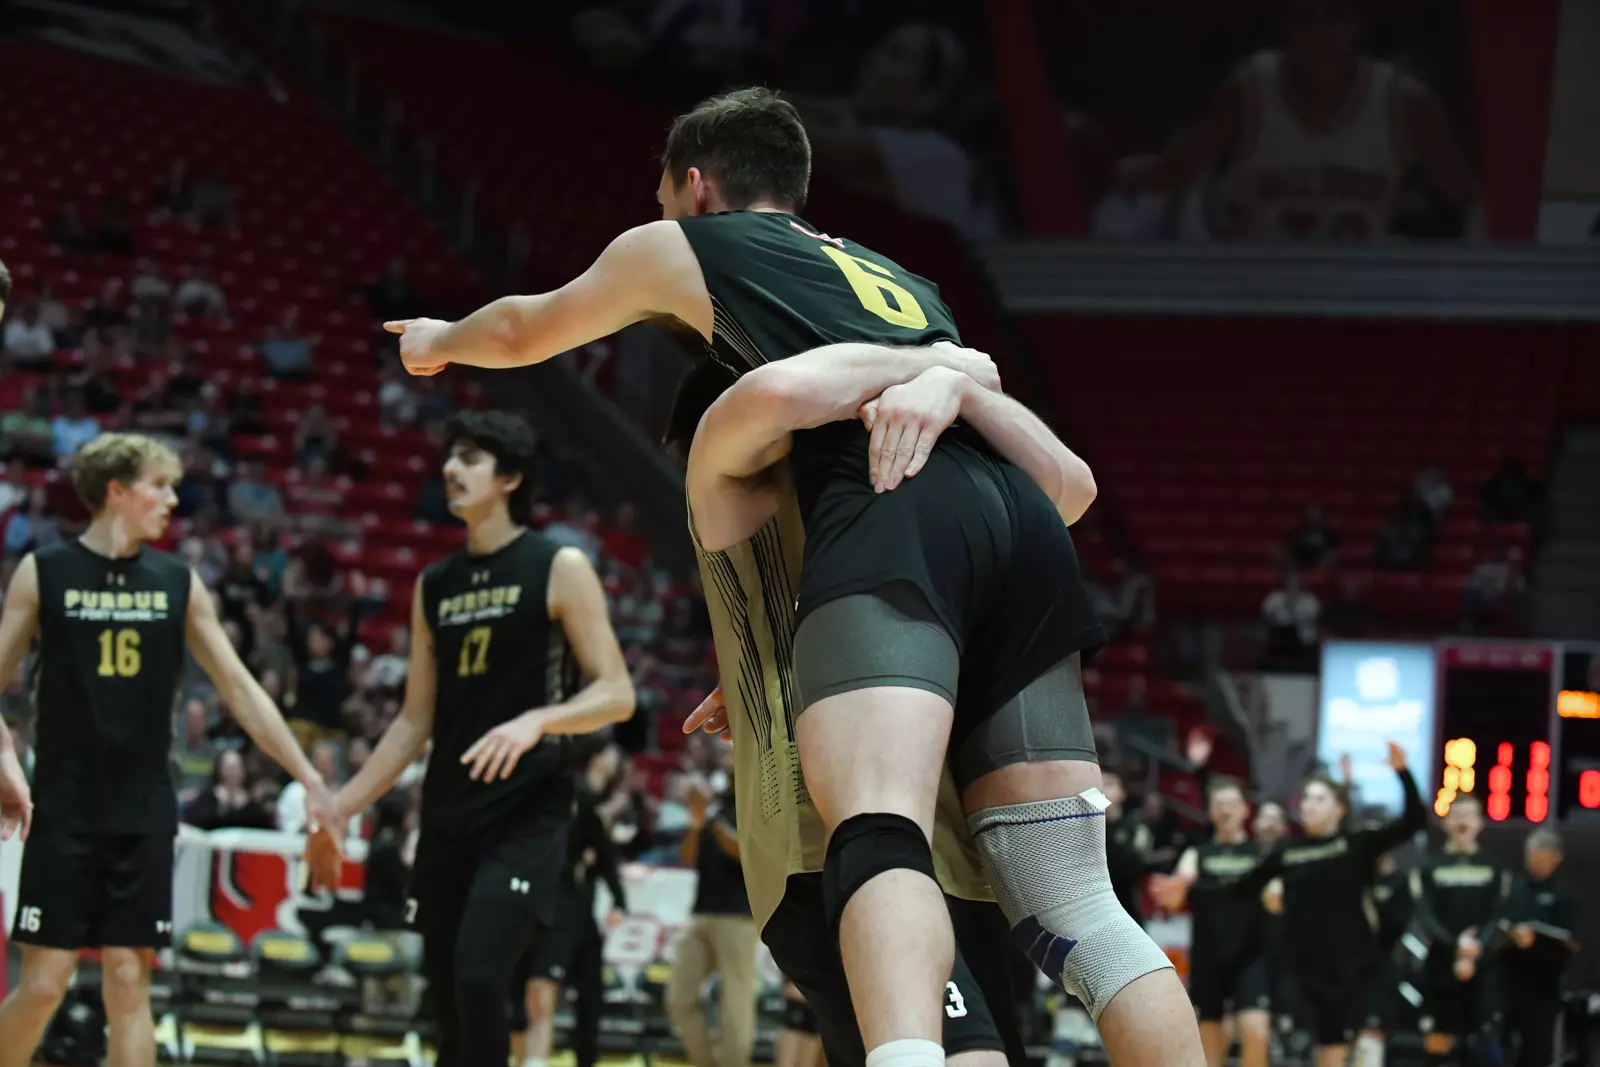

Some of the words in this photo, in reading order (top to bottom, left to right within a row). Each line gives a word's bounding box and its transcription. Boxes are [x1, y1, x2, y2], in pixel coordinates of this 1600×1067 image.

[819, 245, 929, 330] 6
[64, 588, 168, 611] PURDUE
[97, 628, 141, 678] 16
[458, 626, 492, 677] 17
[19, 905, 42, 932] 16
[945, 981, 968, 1019] 3
